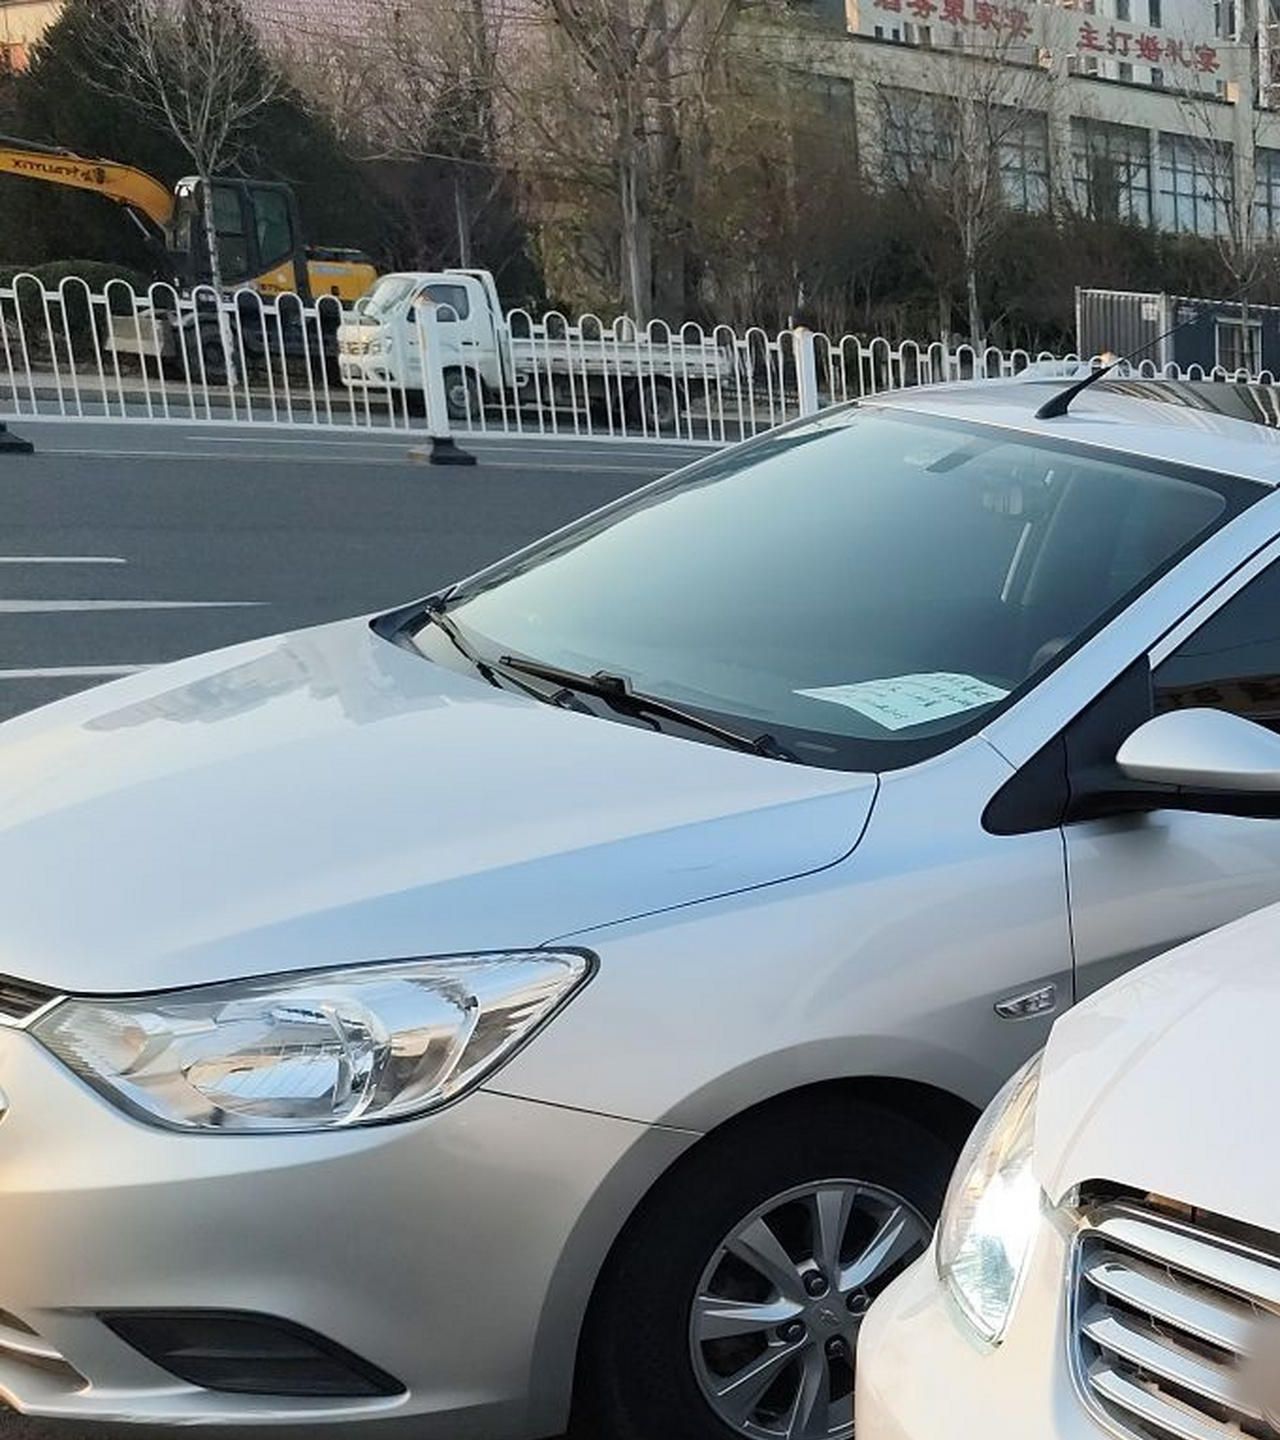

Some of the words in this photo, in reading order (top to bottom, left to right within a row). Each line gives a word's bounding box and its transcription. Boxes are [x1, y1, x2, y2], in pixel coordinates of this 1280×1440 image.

[1076, 21, 1221, 74] 主打婚礼宴
